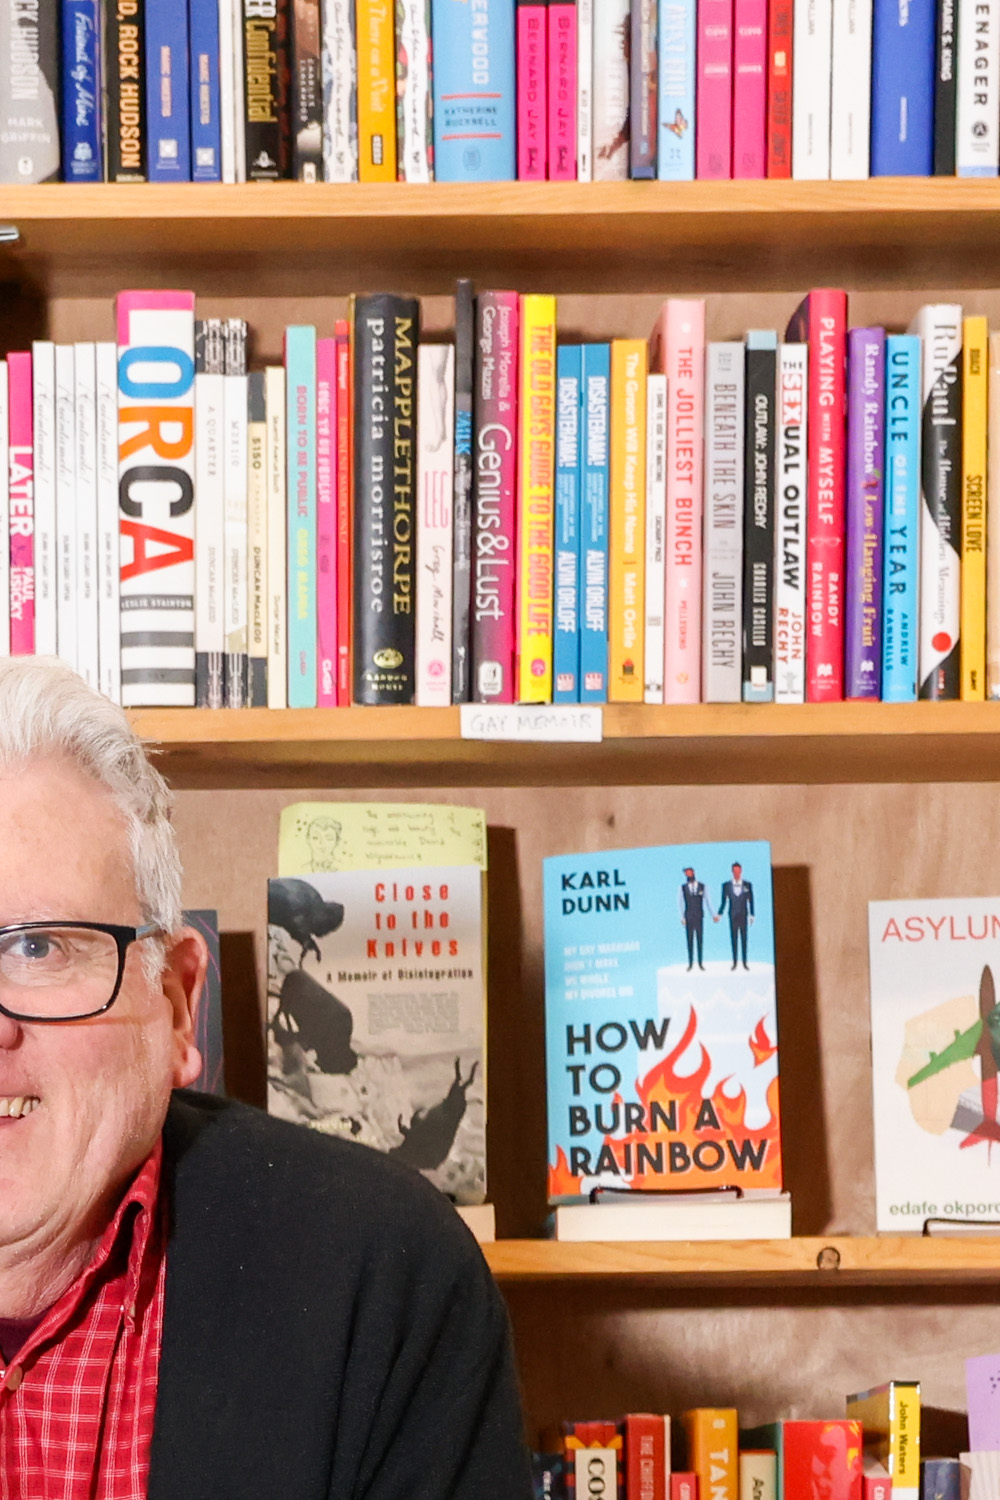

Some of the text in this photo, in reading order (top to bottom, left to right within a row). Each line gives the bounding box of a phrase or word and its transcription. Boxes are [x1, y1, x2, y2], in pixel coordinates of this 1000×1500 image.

[119, 25, 140, 168] ROCK HUDSON
[819, 317, 835, 406] PLAYING
[587, 376, 606, 466] DISASTERAMA!
[891, 351, 908, 442] UNCLE
[118, 291, 194, 583] LORCA
[675, 347, 692, 566] THE JOLLIEST BUNCH
[713, 384, 736, 528] BENEATH THE SKIN
[10, 445, 33, 537] LATER
[367, 318, 388, 613] patricia morrisroe
[394, 317, 412, 614] MAPPLETHORPE
[818, 448, 833, 525] MYSELF
[783, 485, 800, 590] OUTLAW
[889, 527, 906, 596] YEAR
[23, 567, 34, 602] PAUL
[587, 550, 604, 581] ALVIN
[10, 567, 23, 620] LISICKY
[587, 585, 604, 631] ORLOFF
[712, 572, 734, 668] JOHN RECHY
[812, 562, 824, 636] RAINBOW
[827, 572, 838, 625] RANDY
[778, 608, 790, 663] RECHY
[791, 612, 802, 659] JOHN
[470, 715, 505, 733] GAY
[375, 883, 449, 902] Close
[561, 869, 626, 891] KARL
[562, 892, 630, 915] DUNN
[375, 910, 449, 930] to the
[367, 938, 459, 958] Knives
[566, 1018, 671, 1056] HOW
[566, 1063, 621, 1096] TO
[569, 1099, 721, 1136] BURN A
[571, 1139, 767, 1177] RAINBOW
[890, 1200, 937, 1216] edafe
